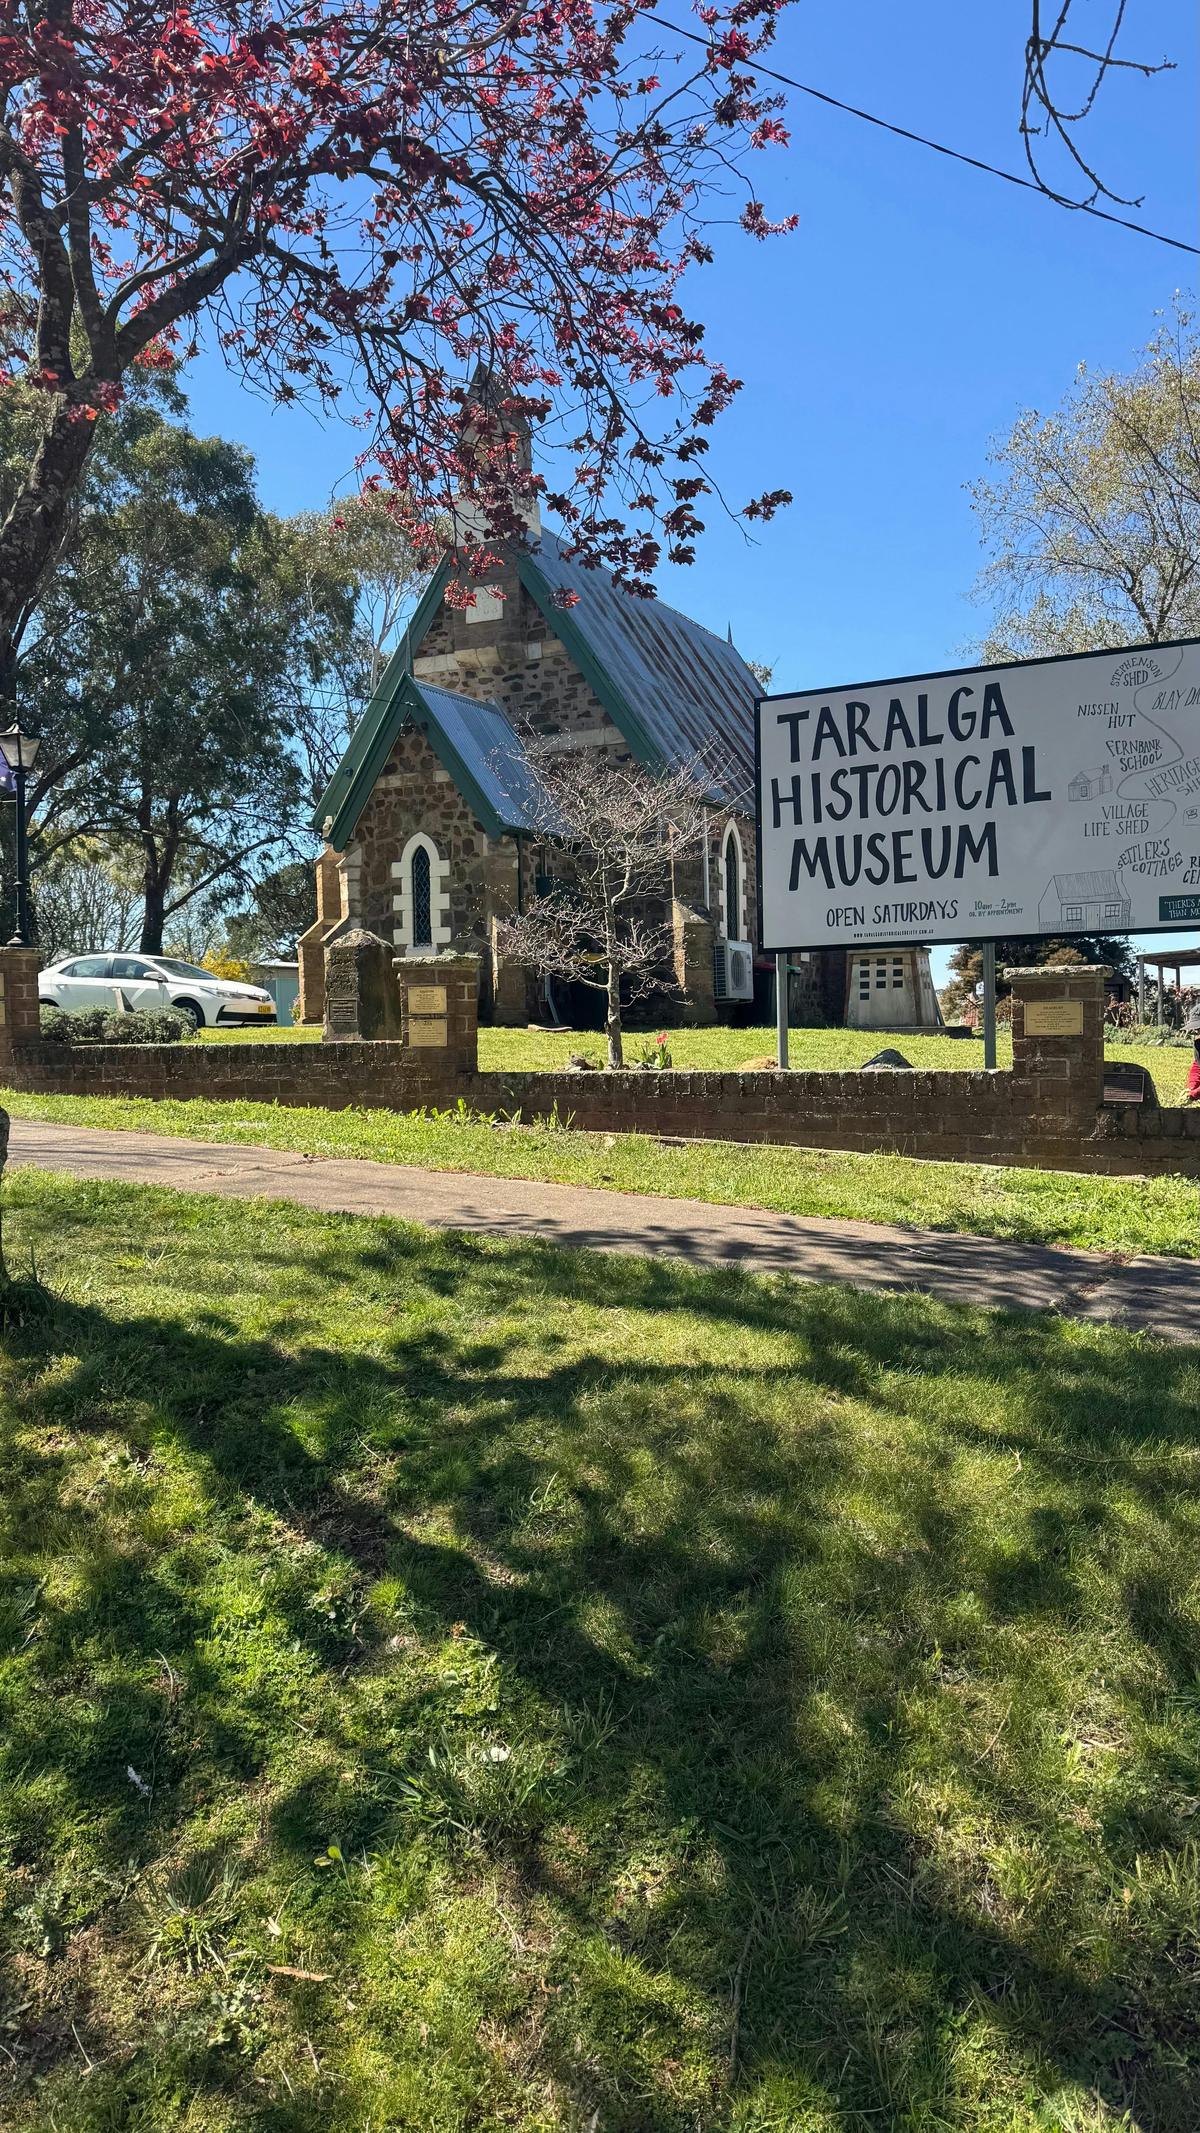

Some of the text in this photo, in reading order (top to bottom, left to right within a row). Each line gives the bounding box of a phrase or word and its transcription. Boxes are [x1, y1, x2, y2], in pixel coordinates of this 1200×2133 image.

[1110, 657, 1163, 687] STEPHENSON
[1123, 670, 1149, 687] SHED
[1077, 702, 1119, 717] NISSEN
[1152, 688, 1187, 710] BLAY
[777, 682, 1015, 763] TARALGA
[1108, 714, 1136, 728] HUT
[1105, 738, 1163, 757] FERNBANK
[1120, 751, 1163, 772] SCHOOL
[771, 745, 1052, 829] HISTORICAL
[1144, 756, 1200, 798] HERITAGE
[1102, 802, 1149, 820] VILLAGE
[1084, 819, 1150, 837] LIFE SHED
[789, 821, 1000, 891] MUSEUM
[1117, 838, 1170, 870] SETTLER'S
[1132, 851, 1184, 877] COTTAGE
[826, 899, 959, 927] OPEN SATURDAYS
[987, 907, 1024, 917] APPOINTMENT
[1168, 908, 1187, 919] THAN
